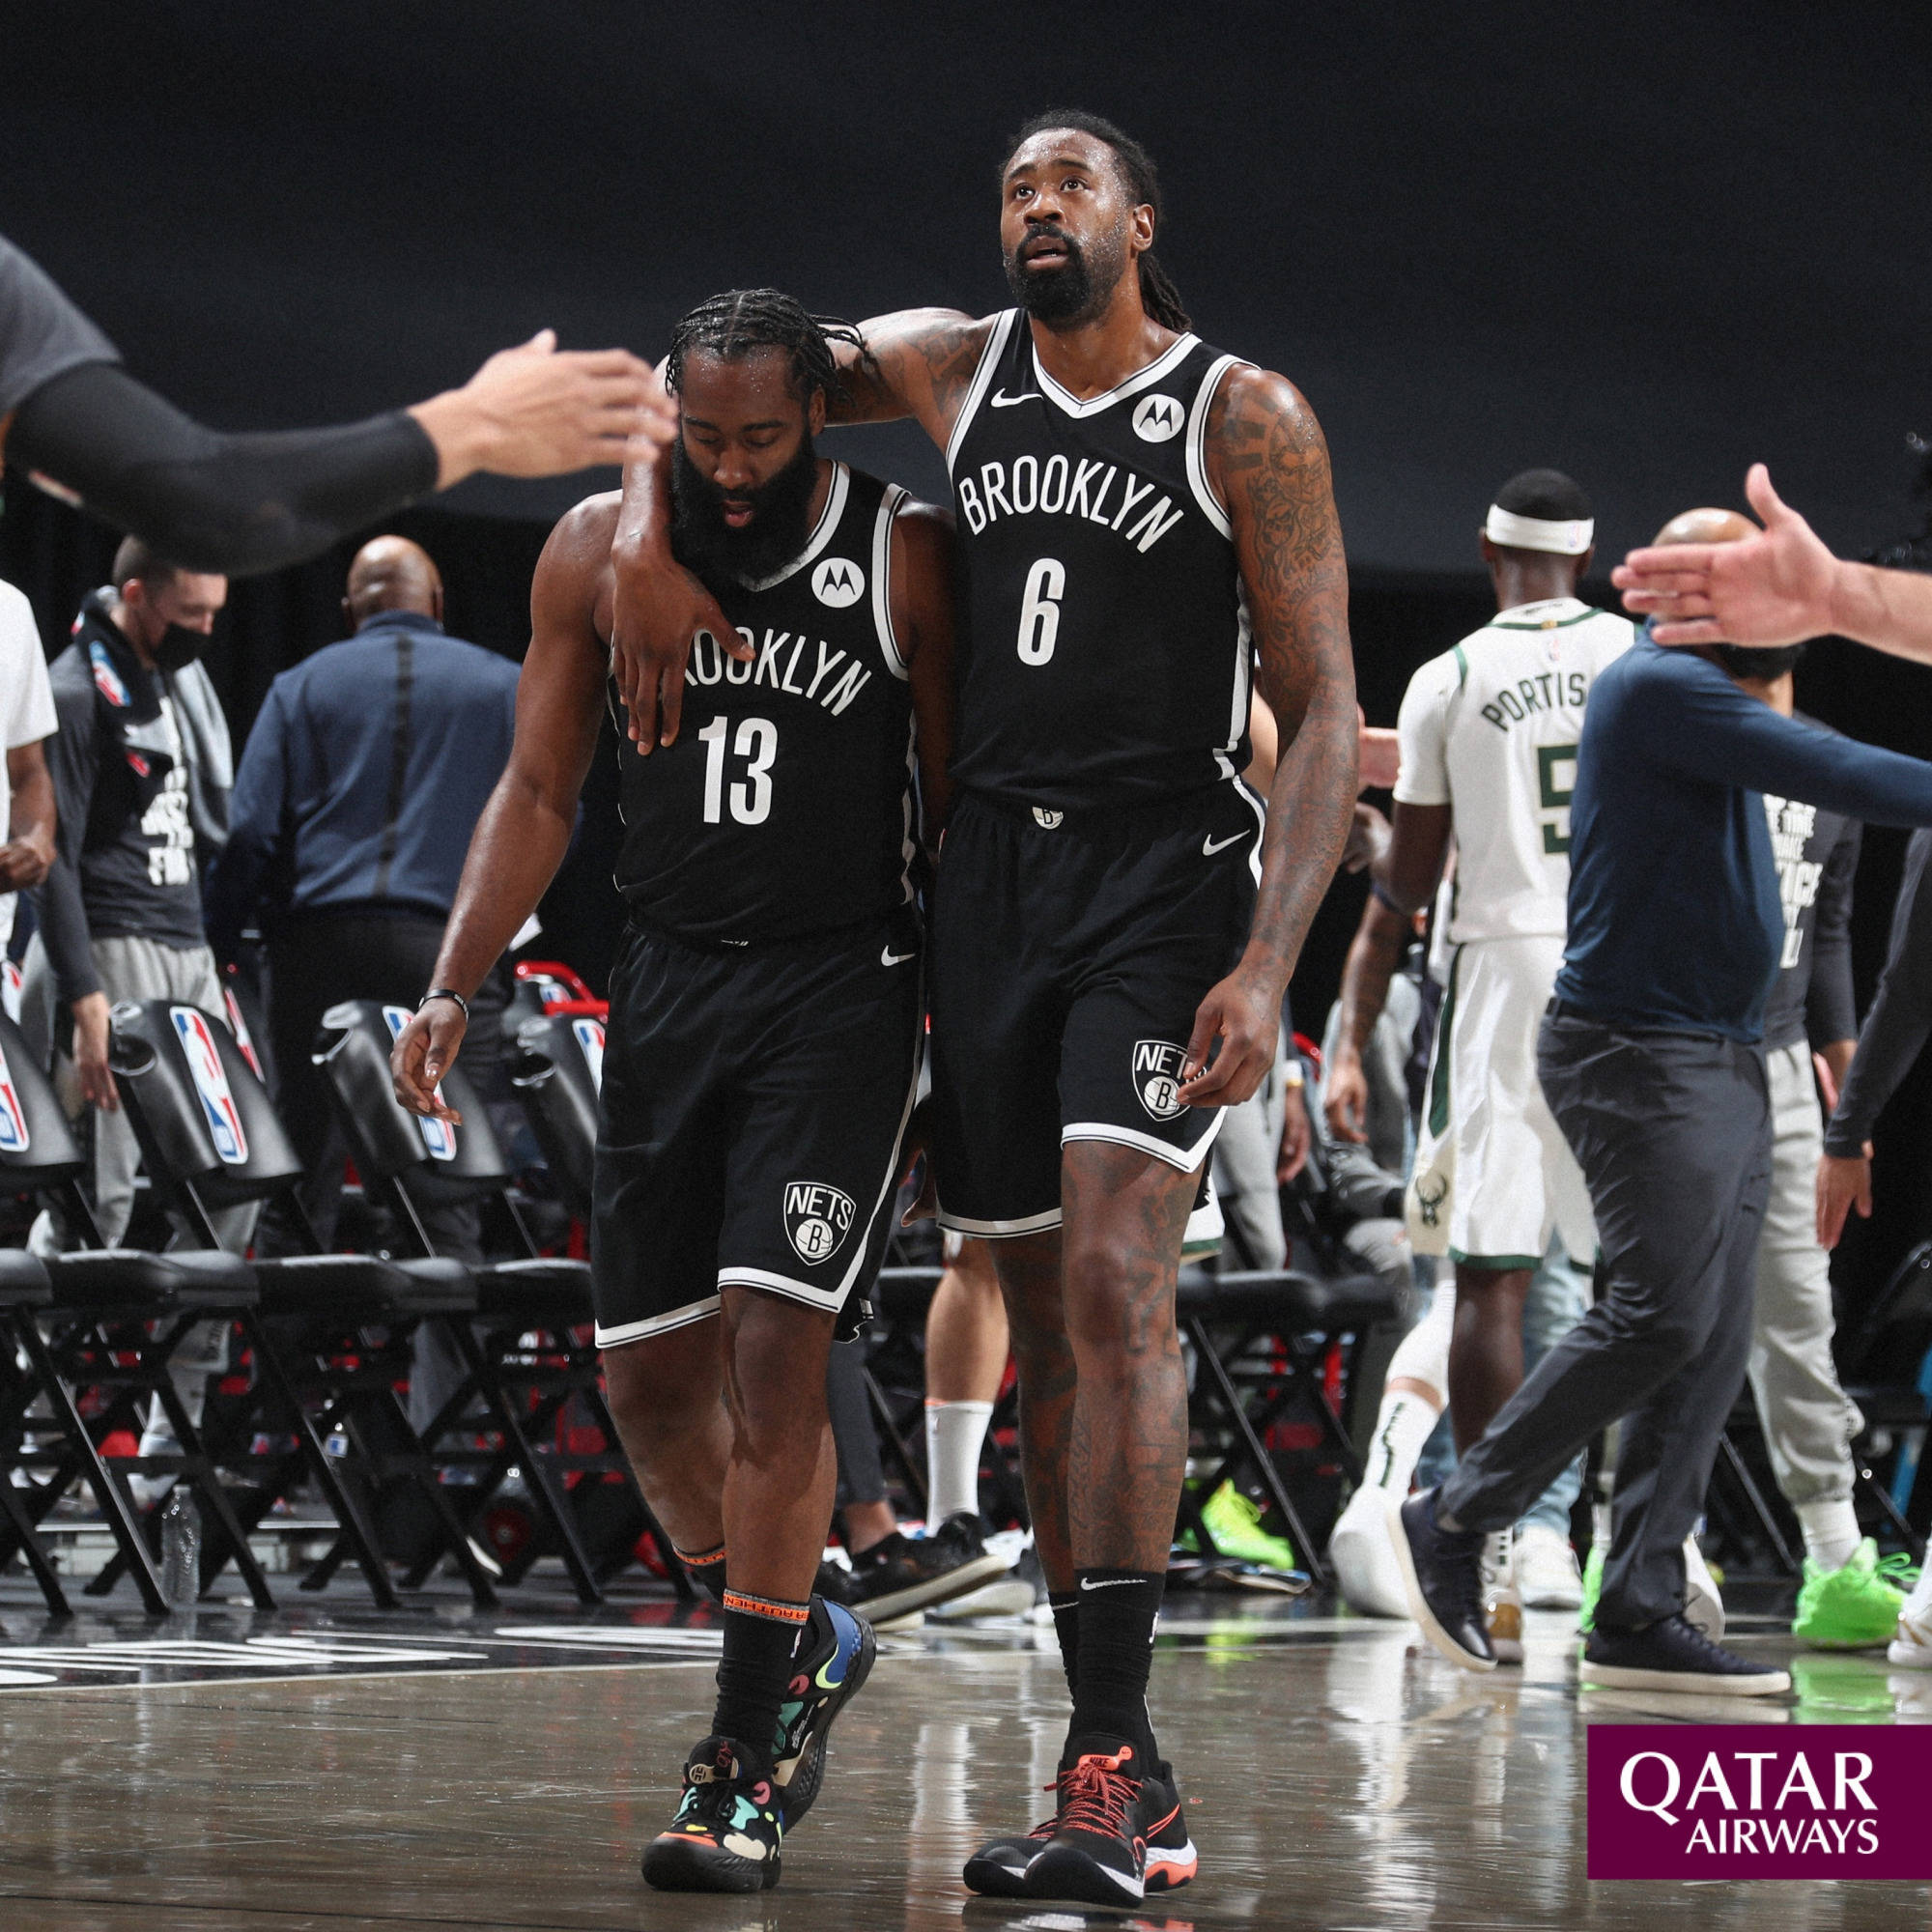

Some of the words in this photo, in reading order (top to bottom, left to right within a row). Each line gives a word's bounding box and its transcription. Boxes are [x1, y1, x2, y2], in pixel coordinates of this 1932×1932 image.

[959, 454, 1184, 554] BROOKLYN
[1017, 557, 1065, 667] 6
[684, 626, 872, 717] OOKLYN
[1481, 672, 1585, 732] PORTIS
[697, 715, 779, 825] 13
[1135, 1043, 1201, 1083] NET
[787, 1185, 852, 1231] NETS
